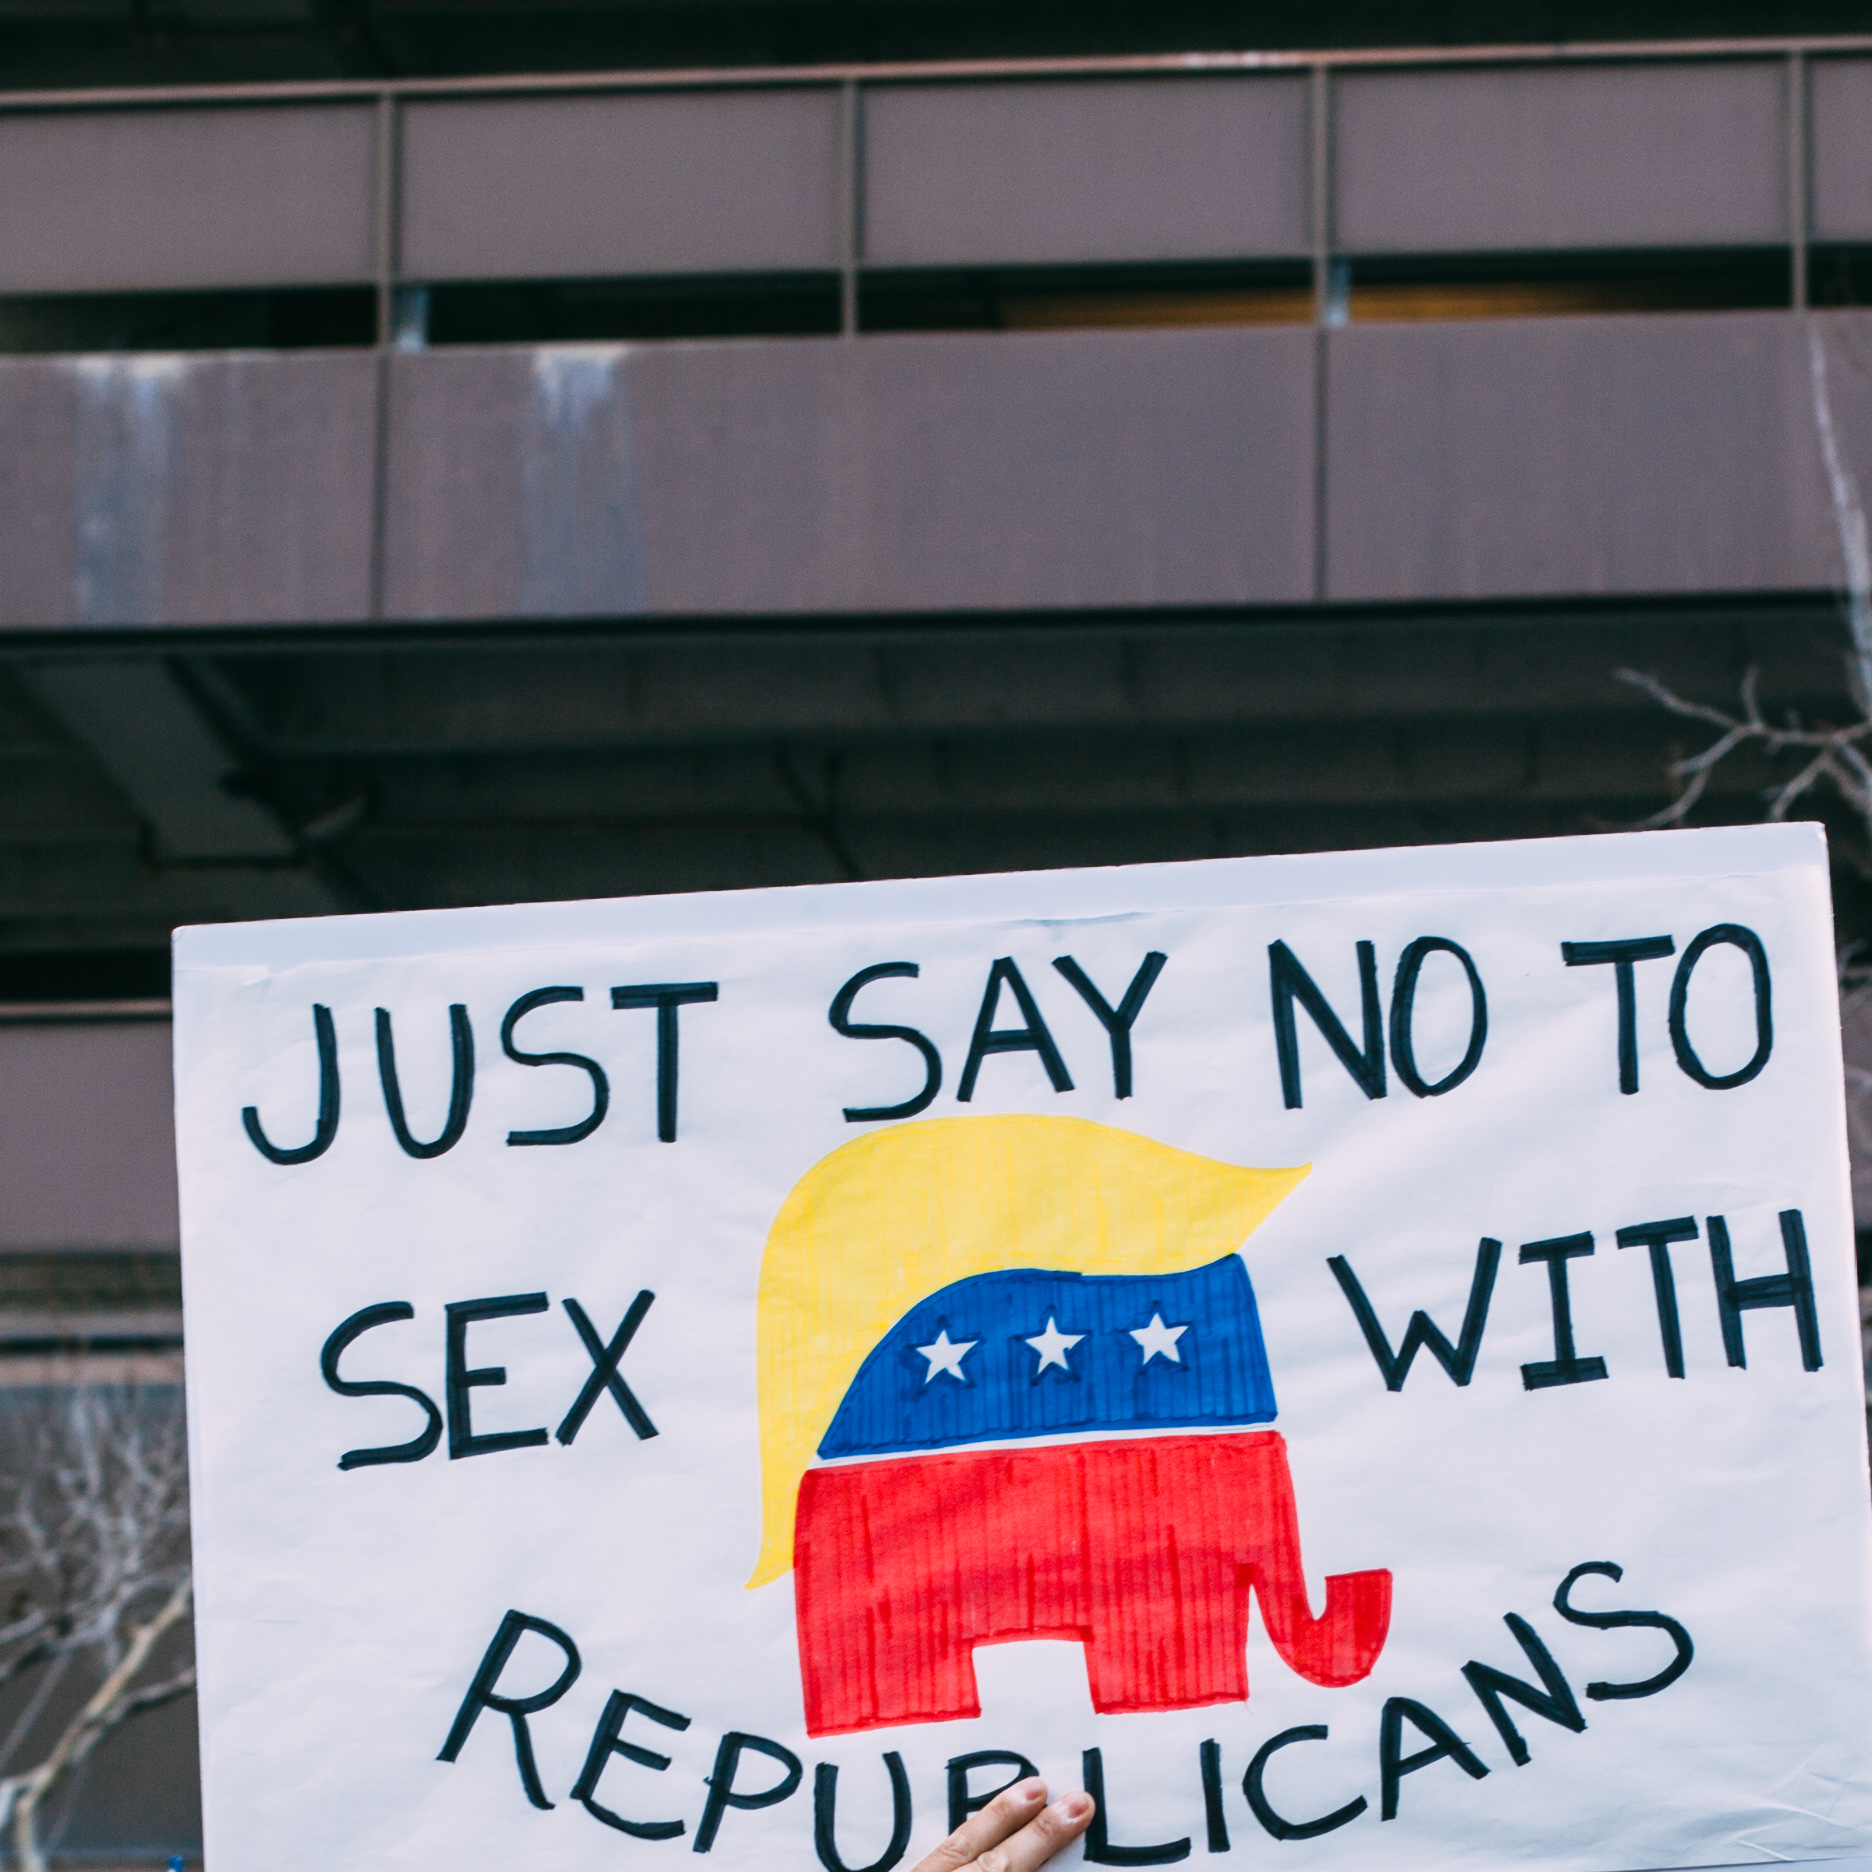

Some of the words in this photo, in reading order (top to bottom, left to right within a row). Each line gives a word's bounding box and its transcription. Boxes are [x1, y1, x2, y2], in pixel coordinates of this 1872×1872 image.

[240, 979, 721, 1167] JUST
[827, 949, 1170, 1124] SAY
[1266, 933, 1491, 1111] NO
[1559, 921, 1775, 1095] TO
[318, 1287, 660, 1471] SEX
[1325, 1207, 1828, 1393] WITH
